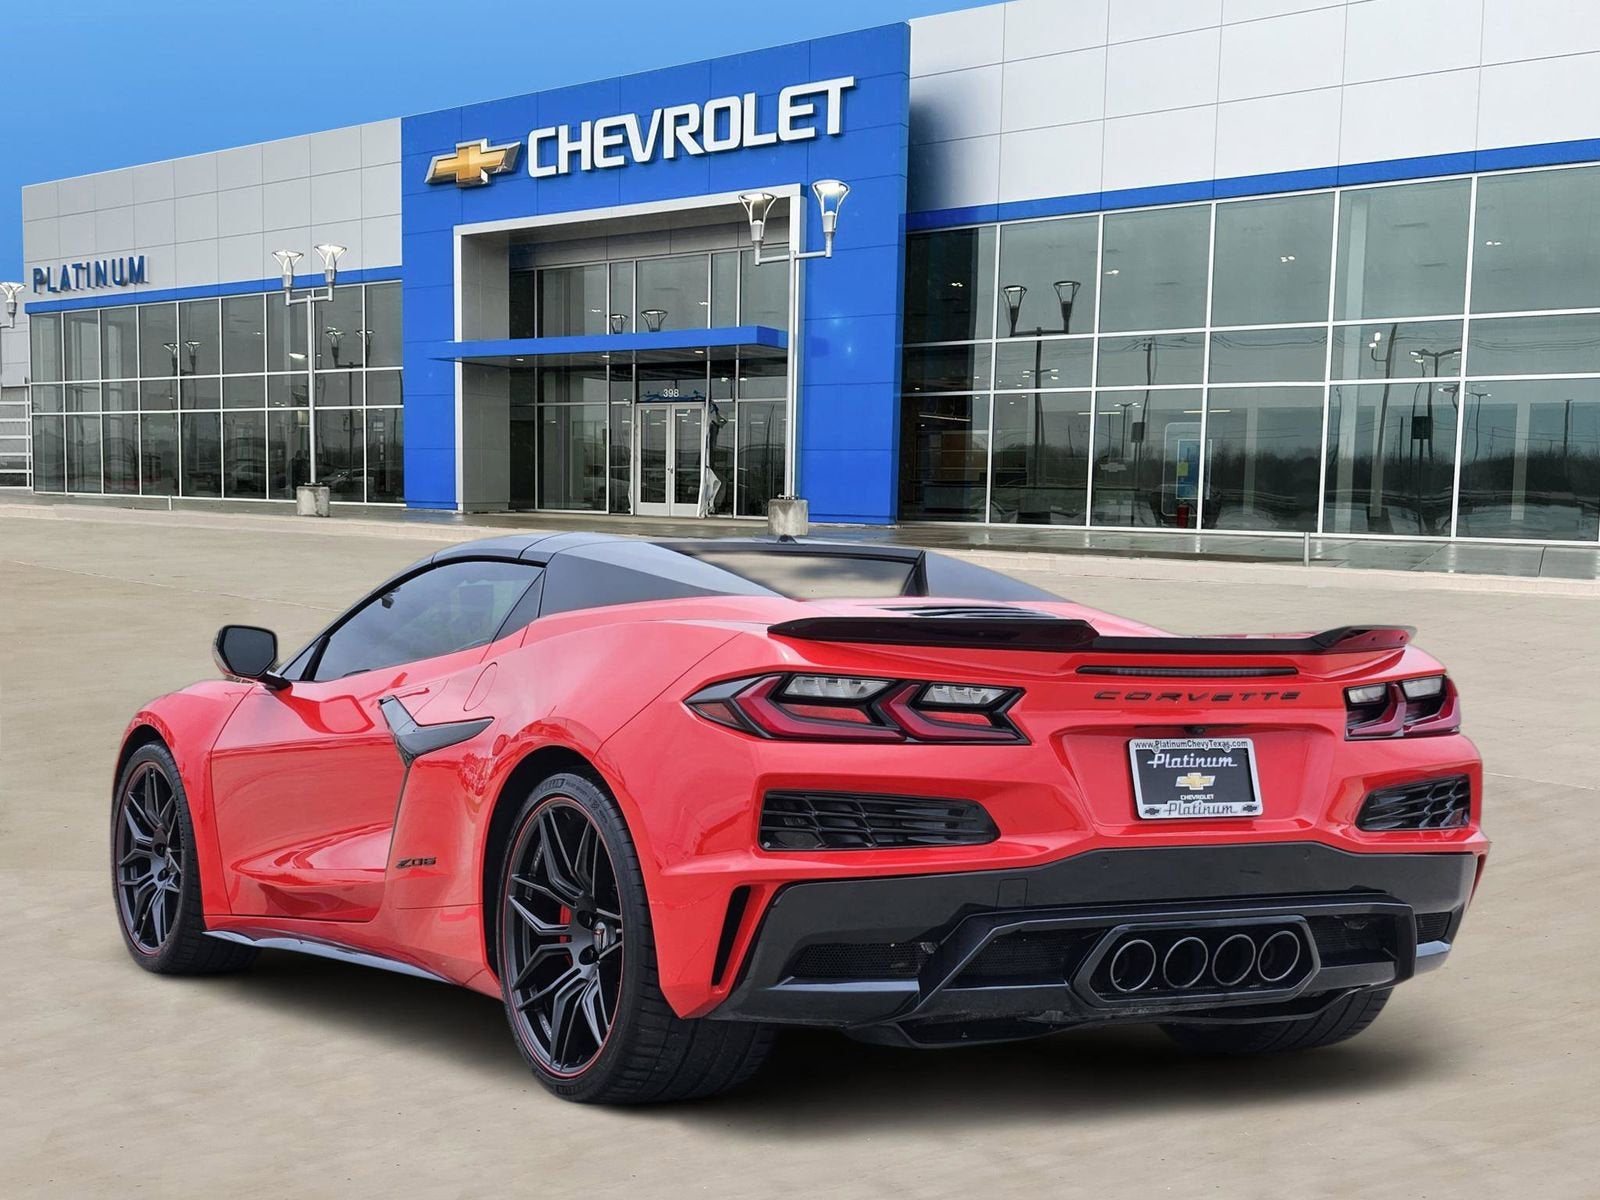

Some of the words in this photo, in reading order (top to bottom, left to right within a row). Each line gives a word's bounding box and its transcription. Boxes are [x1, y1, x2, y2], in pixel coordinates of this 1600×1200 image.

[527, 75, 857, 178] CHEVROLET
[33, 255, 145, 293] PLATINUM
[663, 388, 679, 398] 398
[1094, 691, 1300, 702] CORVETTE
[1134, 739, 1248, 749] www.PlatinumChevyTexas.com
[1147, 752, 1238, 769] Platinum
[1163, 800, 1238, 816] Platinum
[396, 857, 437, 869] Z06
